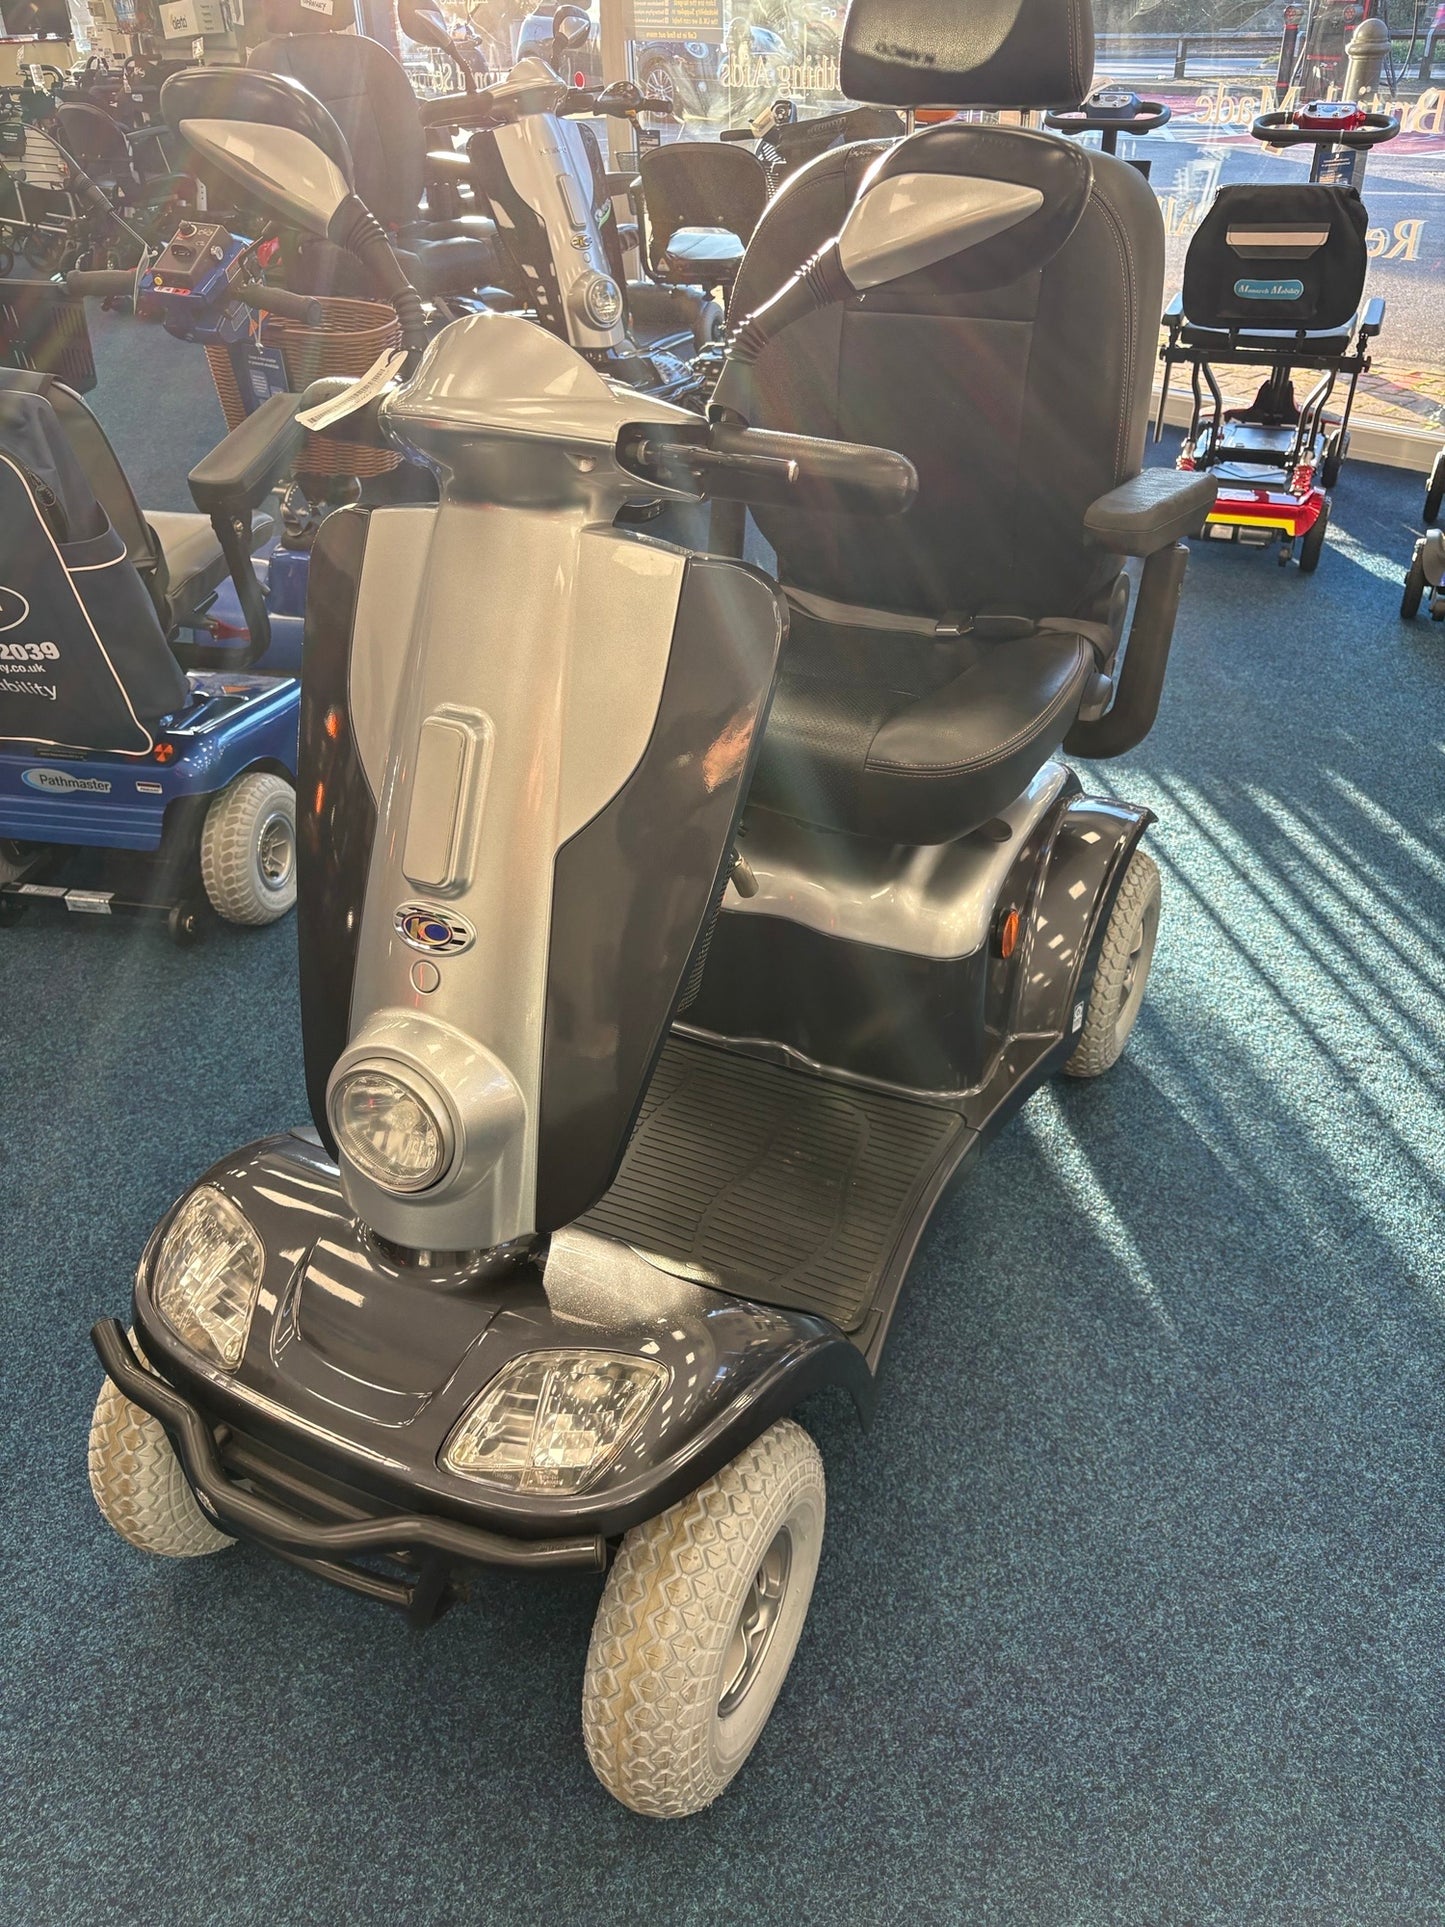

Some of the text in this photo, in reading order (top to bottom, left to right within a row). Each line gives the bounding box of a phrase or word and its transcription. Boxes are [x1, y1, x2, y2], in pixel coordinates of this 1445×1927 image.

[1238, 284, 1300, 296] Monarch Mobility
[39, 774, 110, 791] Pathmaster
